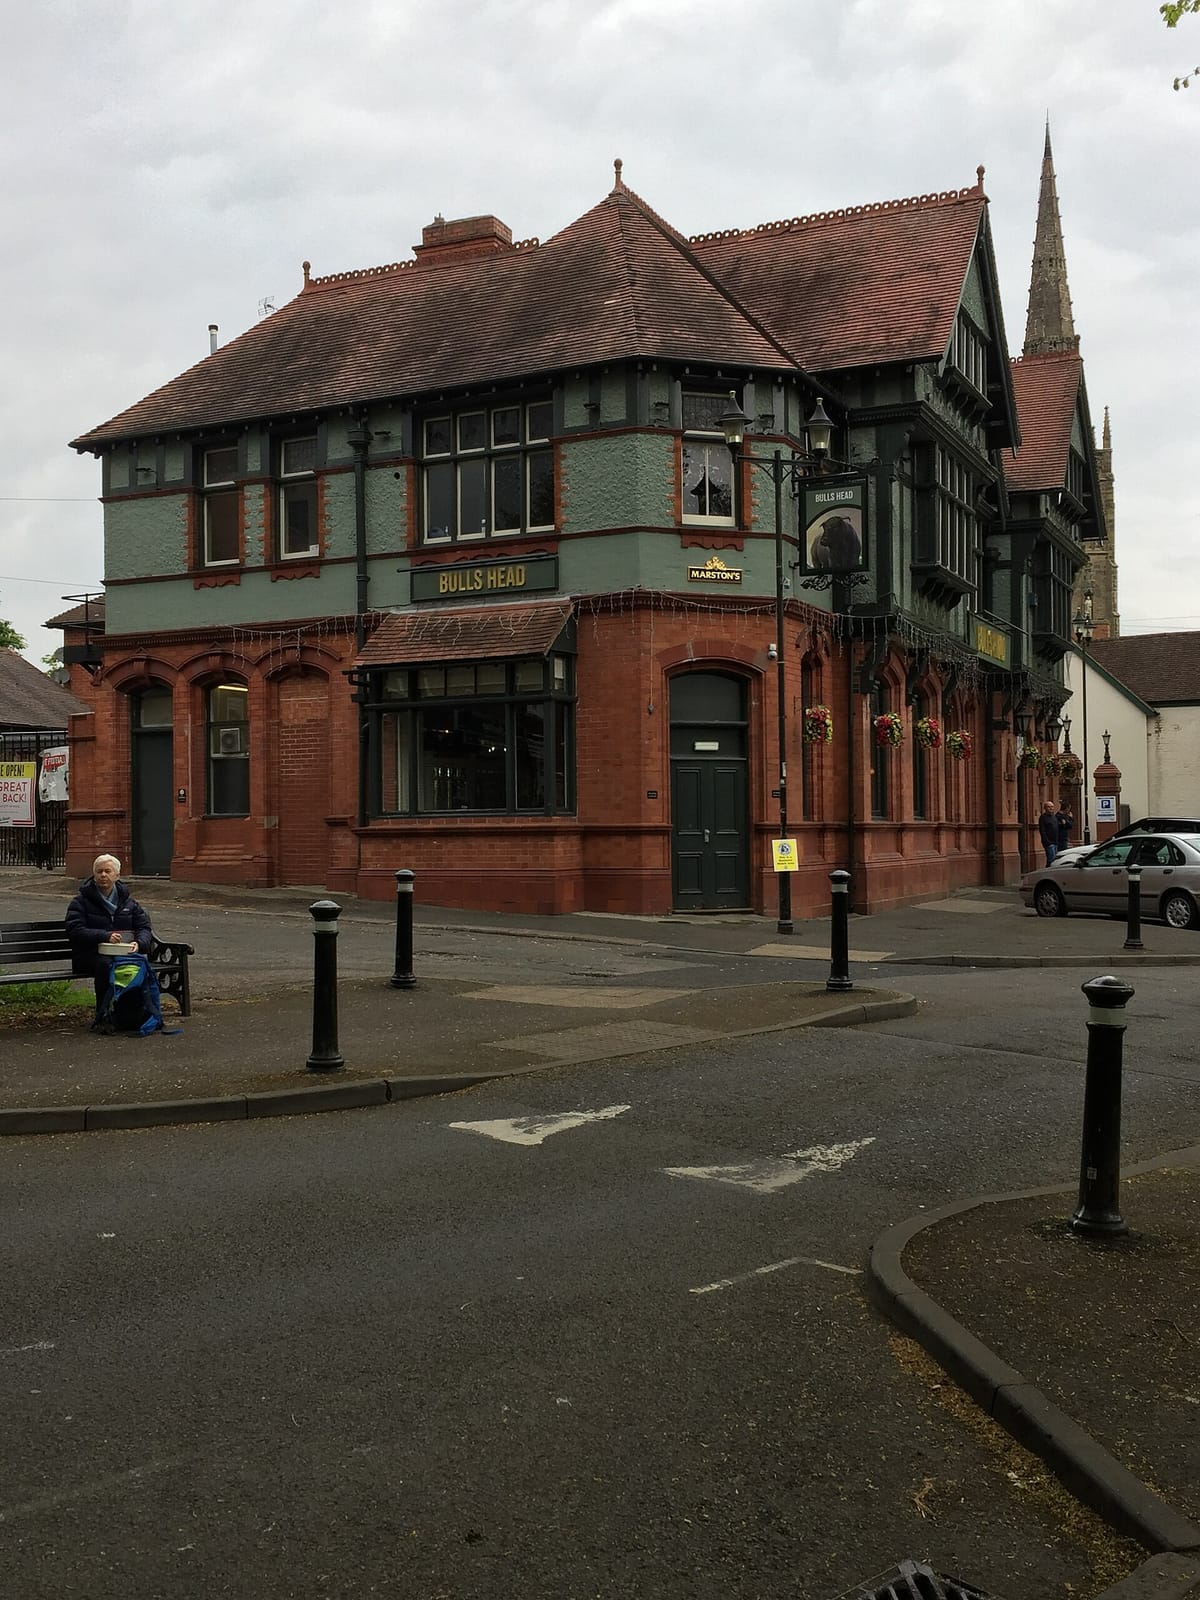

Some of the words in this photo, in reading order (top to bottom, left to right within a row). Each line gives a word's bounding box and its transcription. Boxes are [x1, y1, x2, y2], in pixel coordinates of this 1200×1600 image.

[815, 492, 835, 503] BULLS
[836, 490, 854, 501] HEAD
[439, 569, 483, 593] BULLS
[487, 565, 526, 589] HEAD
[691, 570, 740, 580] MARSTON'S
[6, 764, 24, 777] OPEN!
[2, 793, 27, 803] BACK!
